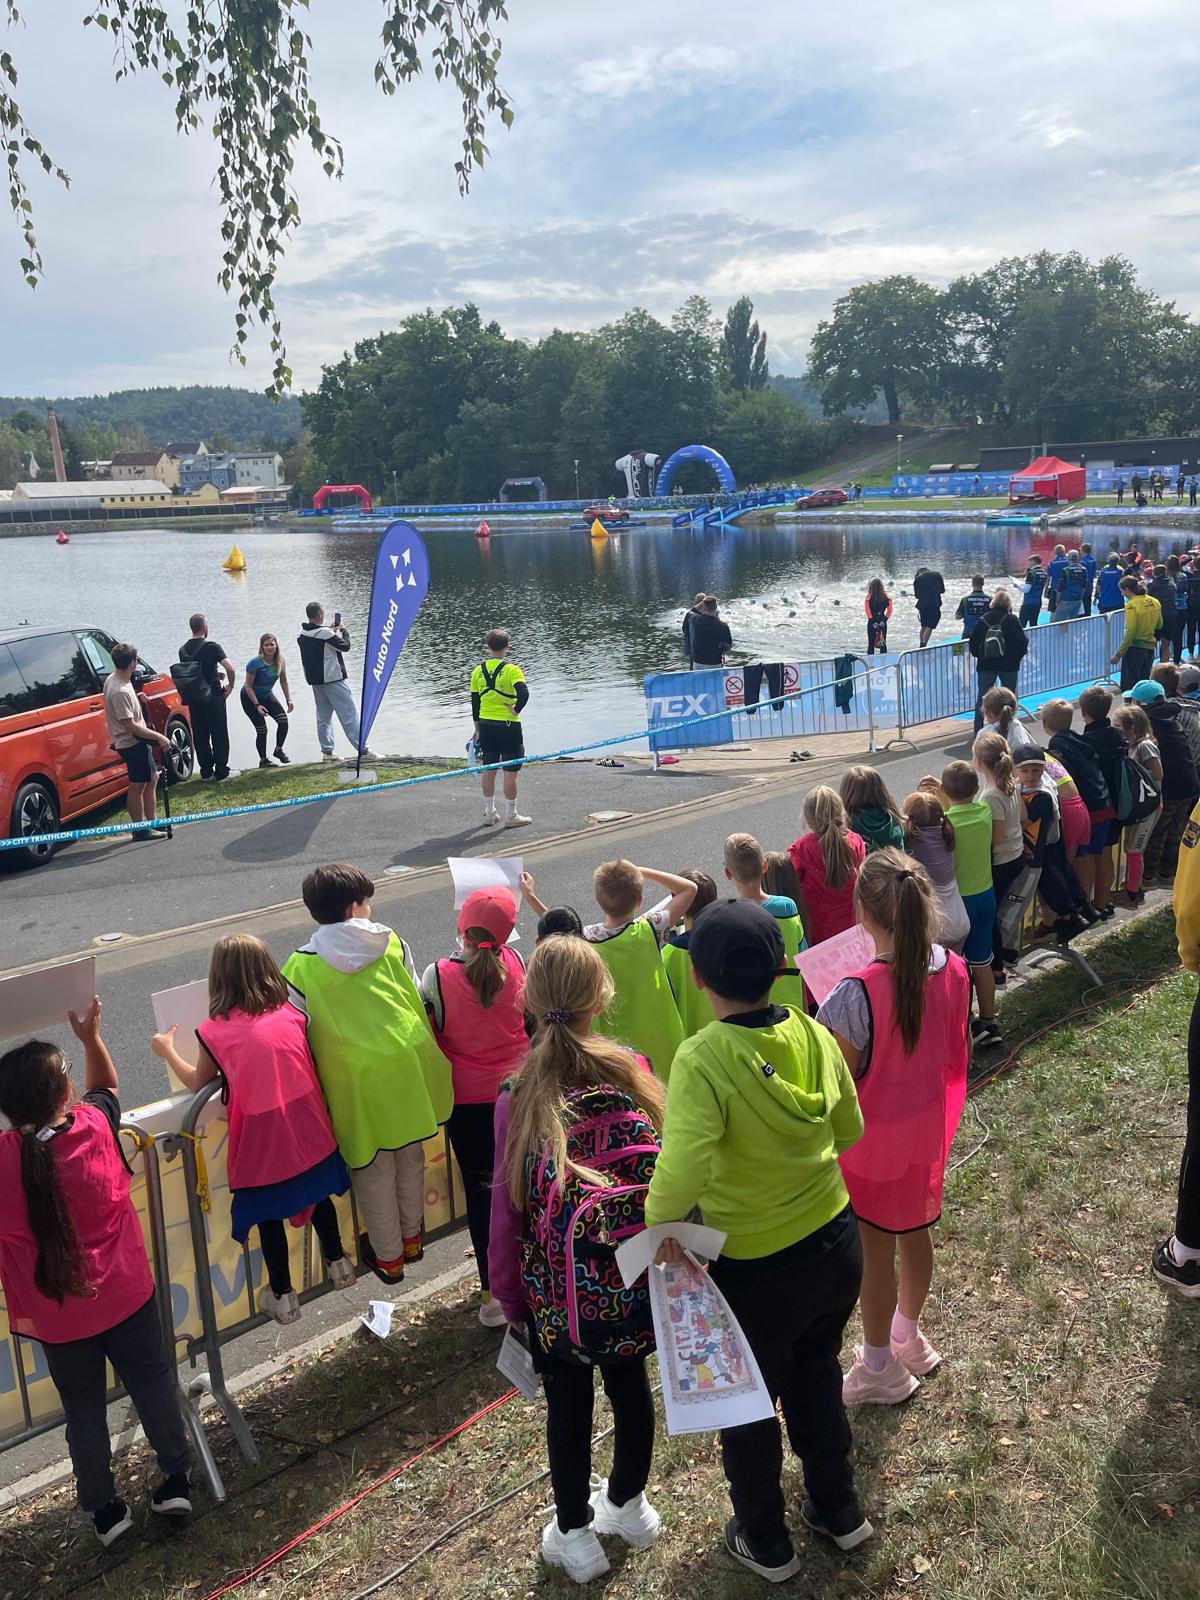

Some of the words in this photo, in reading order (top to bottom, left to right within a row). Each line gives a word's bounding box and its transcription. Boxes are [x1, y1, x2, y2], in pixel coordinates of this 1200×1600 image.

[373, 643, 388, 682] Auto
[381, 598, 398, 643] Nord
[258, 800, 290, 808] TRIATHLON
[188, 810, 224, 820] TRIATHLON
[96, 826, 112, 834] CITY
[113, 821, 152, 831] TRIATHLON
[12, 838, 29, 846] CITY
[31, 831, 73, 842] TRIATHLON
[674, 1325, 692, 1361] CITY
